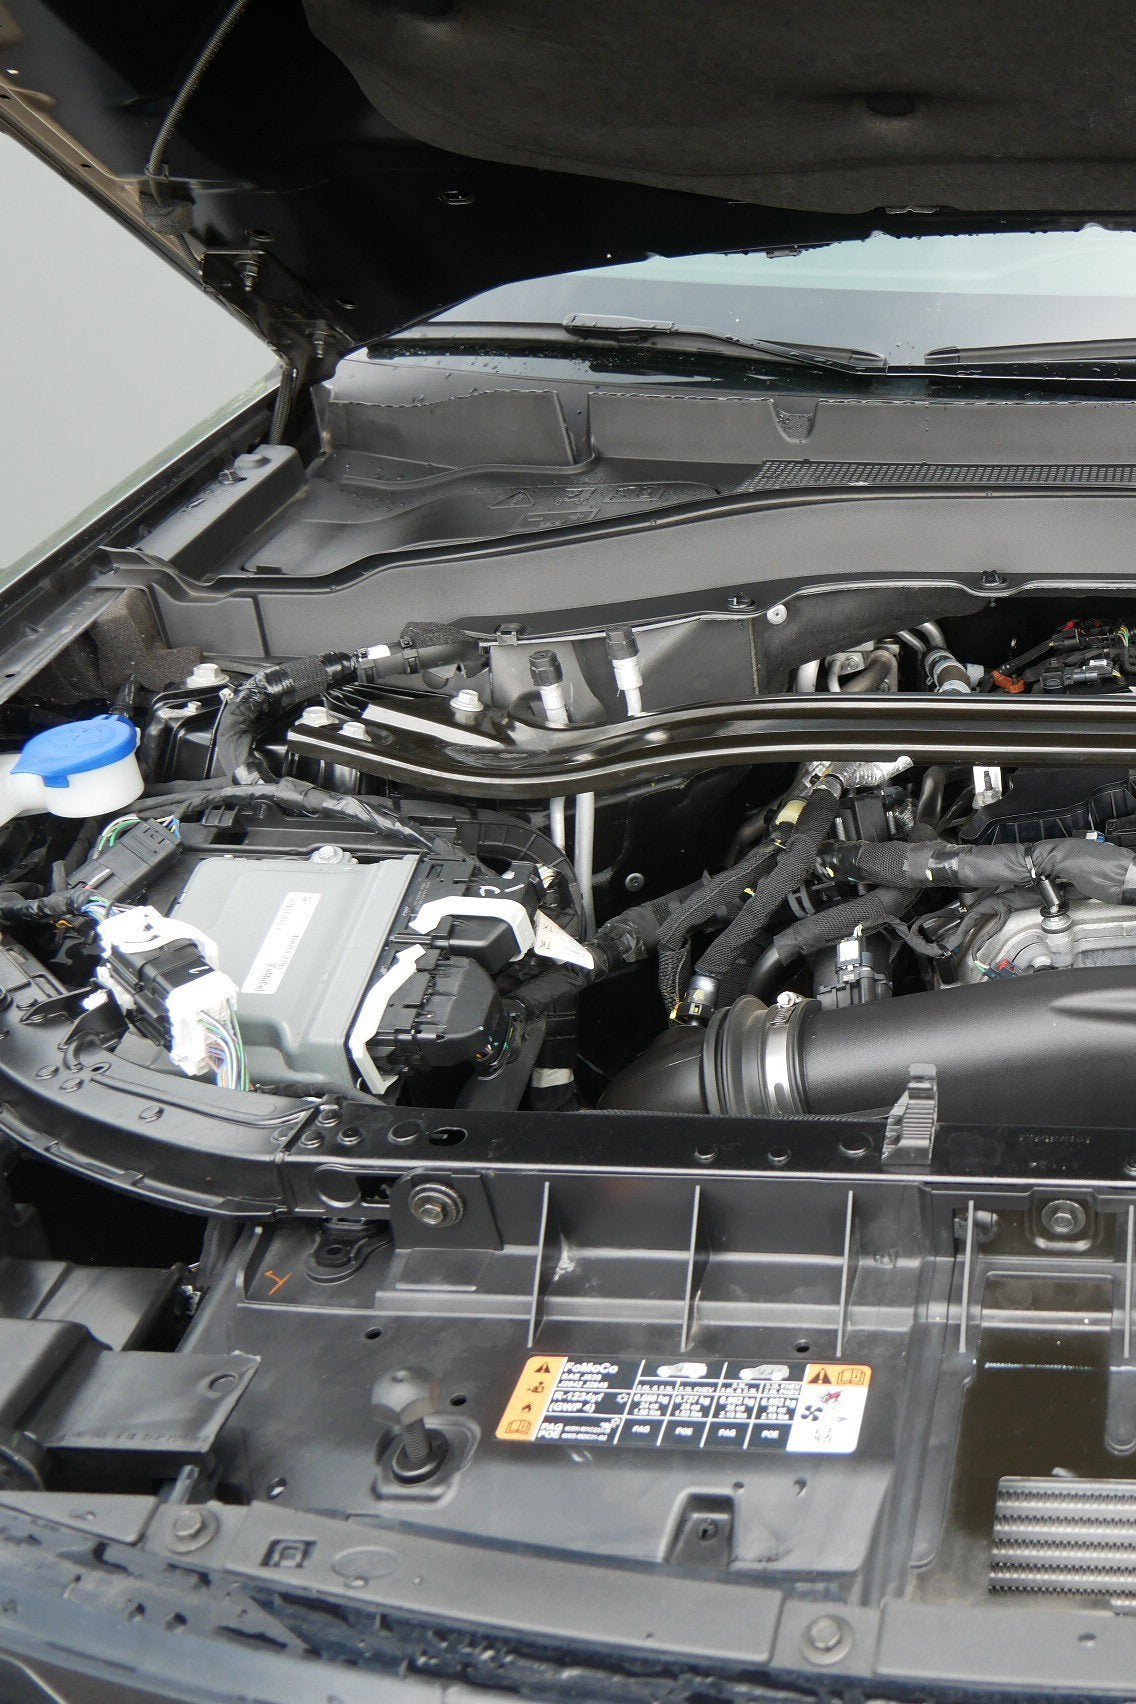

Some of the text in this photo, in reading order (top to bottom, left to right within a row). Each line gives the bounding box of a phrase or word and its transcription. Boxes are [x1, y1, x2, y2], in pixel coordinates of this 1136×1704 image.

[563, 1362, 619, 1374] FoMoCo
[553, 1391, 605, 1403] R-1234yf
[548, 1402, 596, 1413] (GWP 4)
[537, 1430, 561, 1439] POE
